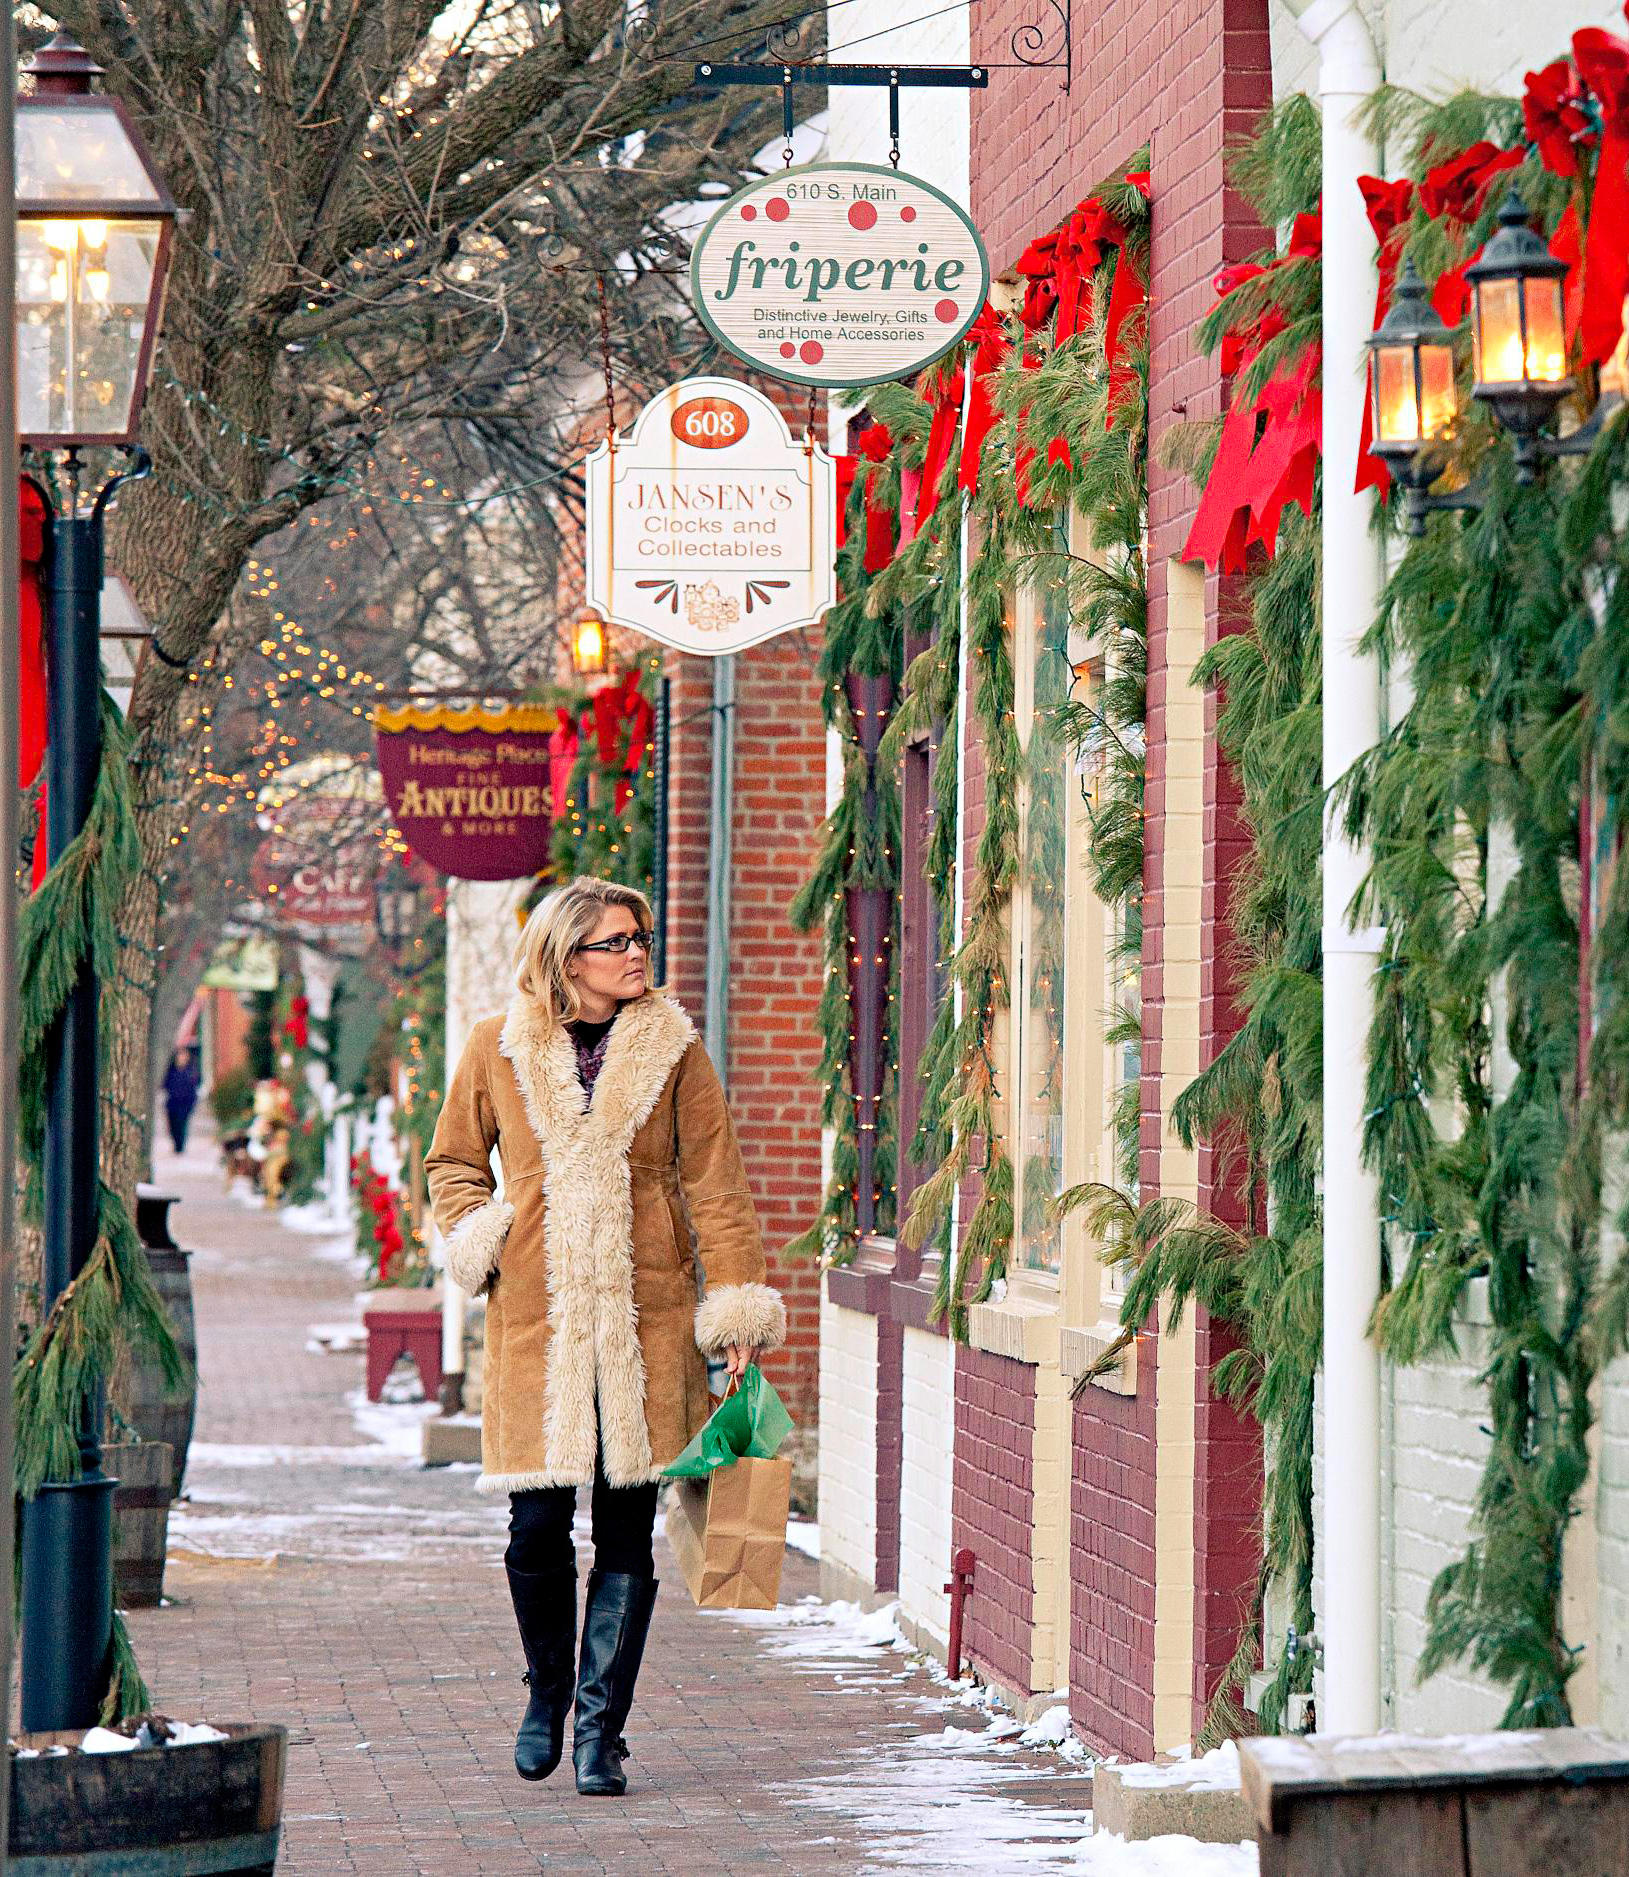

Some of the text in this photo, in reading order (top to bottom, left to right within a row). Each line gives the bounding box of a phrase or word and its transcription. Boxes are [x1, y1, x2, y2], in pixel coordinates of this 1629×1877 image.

[786, 183, 896, 200] 610 S. Main
[714, 240, 965, 302] friperie
[753, 308, 928, 325] Distinctive Jewelry, Gifts
[757, 327, 925, 341] and Home Accessories
[685, 411, 736, 437] 608
[628, 484, 793, 511] JANSEN'S
[644, 516, 777, 534] Clocks and
[637, 539, 783, 557] Collectables
[398, 780, 552, 818] ANTIQUES
[462, 822, 516, 836] MORE
